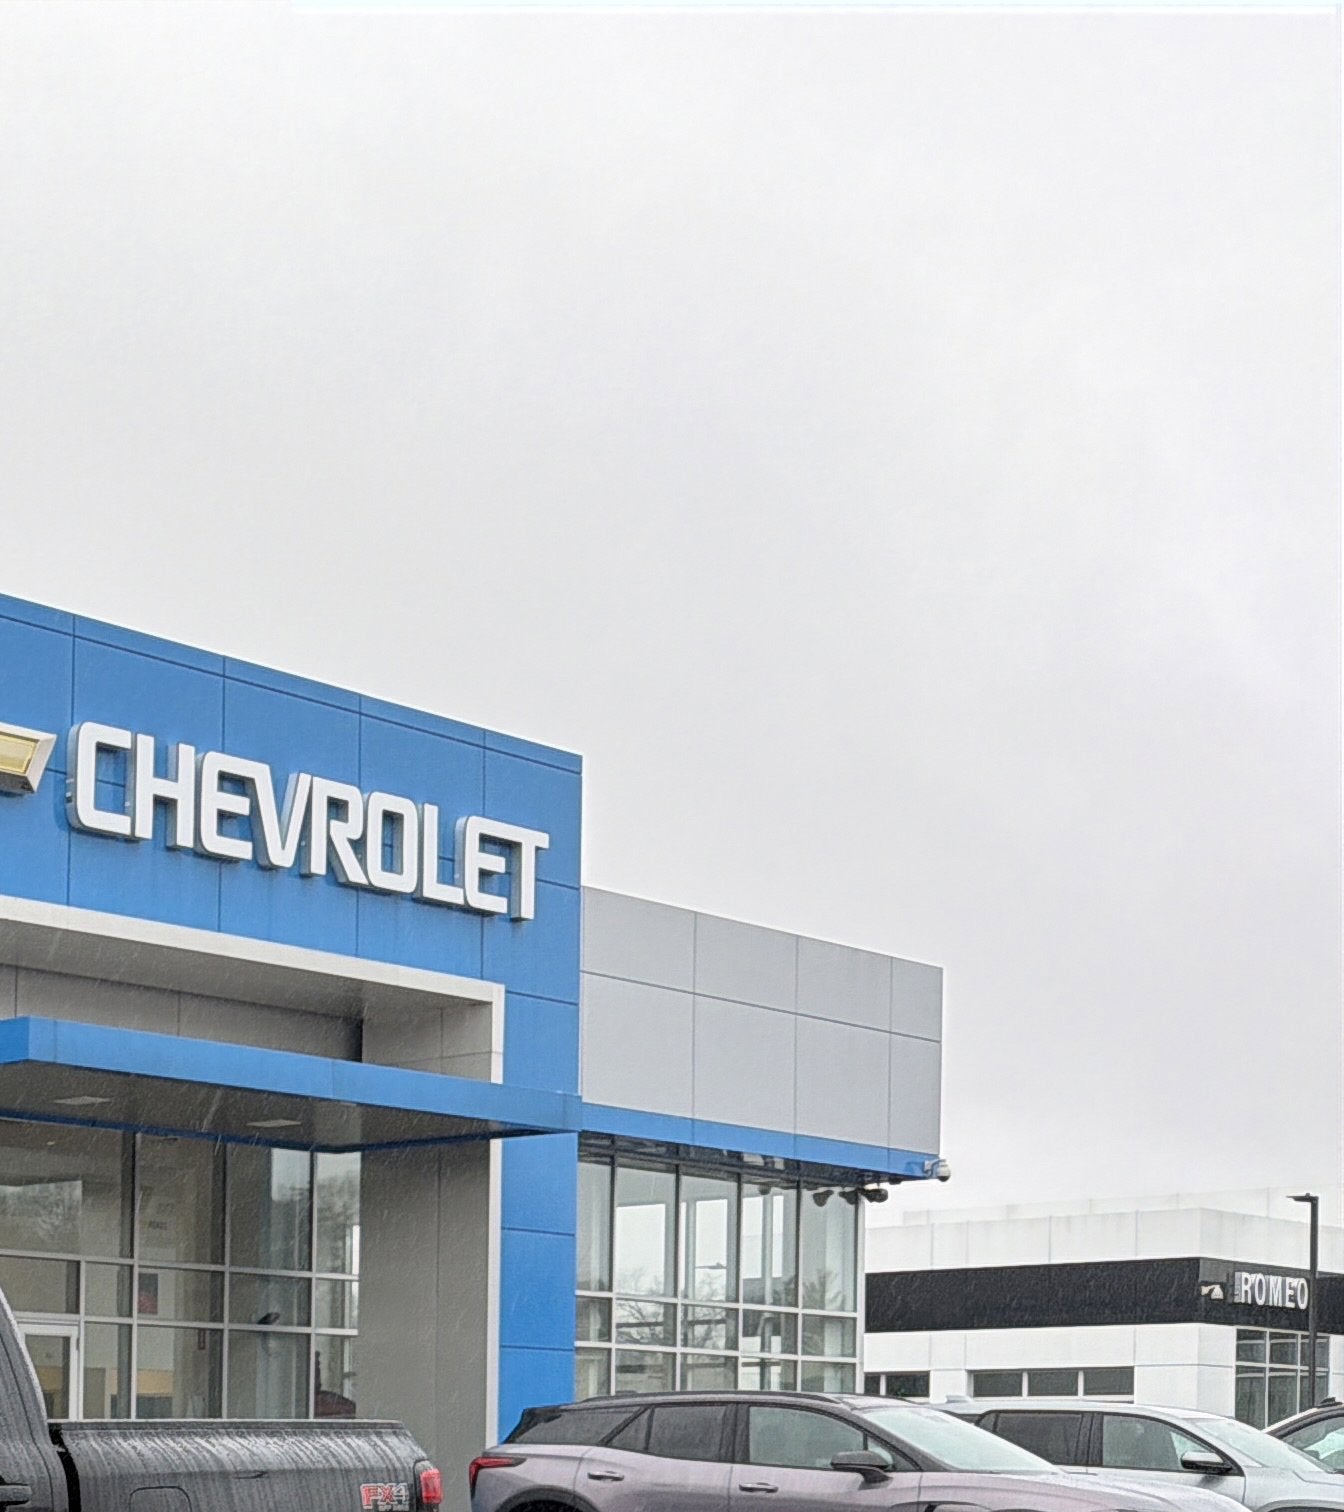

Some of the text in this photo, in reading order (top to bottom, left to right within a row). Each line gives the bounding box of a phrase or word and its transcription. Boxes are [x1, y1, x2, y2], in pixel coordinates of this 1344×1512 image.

[66, 721, 550, 921] CHEVROLET
[1235, 1272, 1309, 1310] ROMEO
[360, 1483, 410, 1509] FX4
